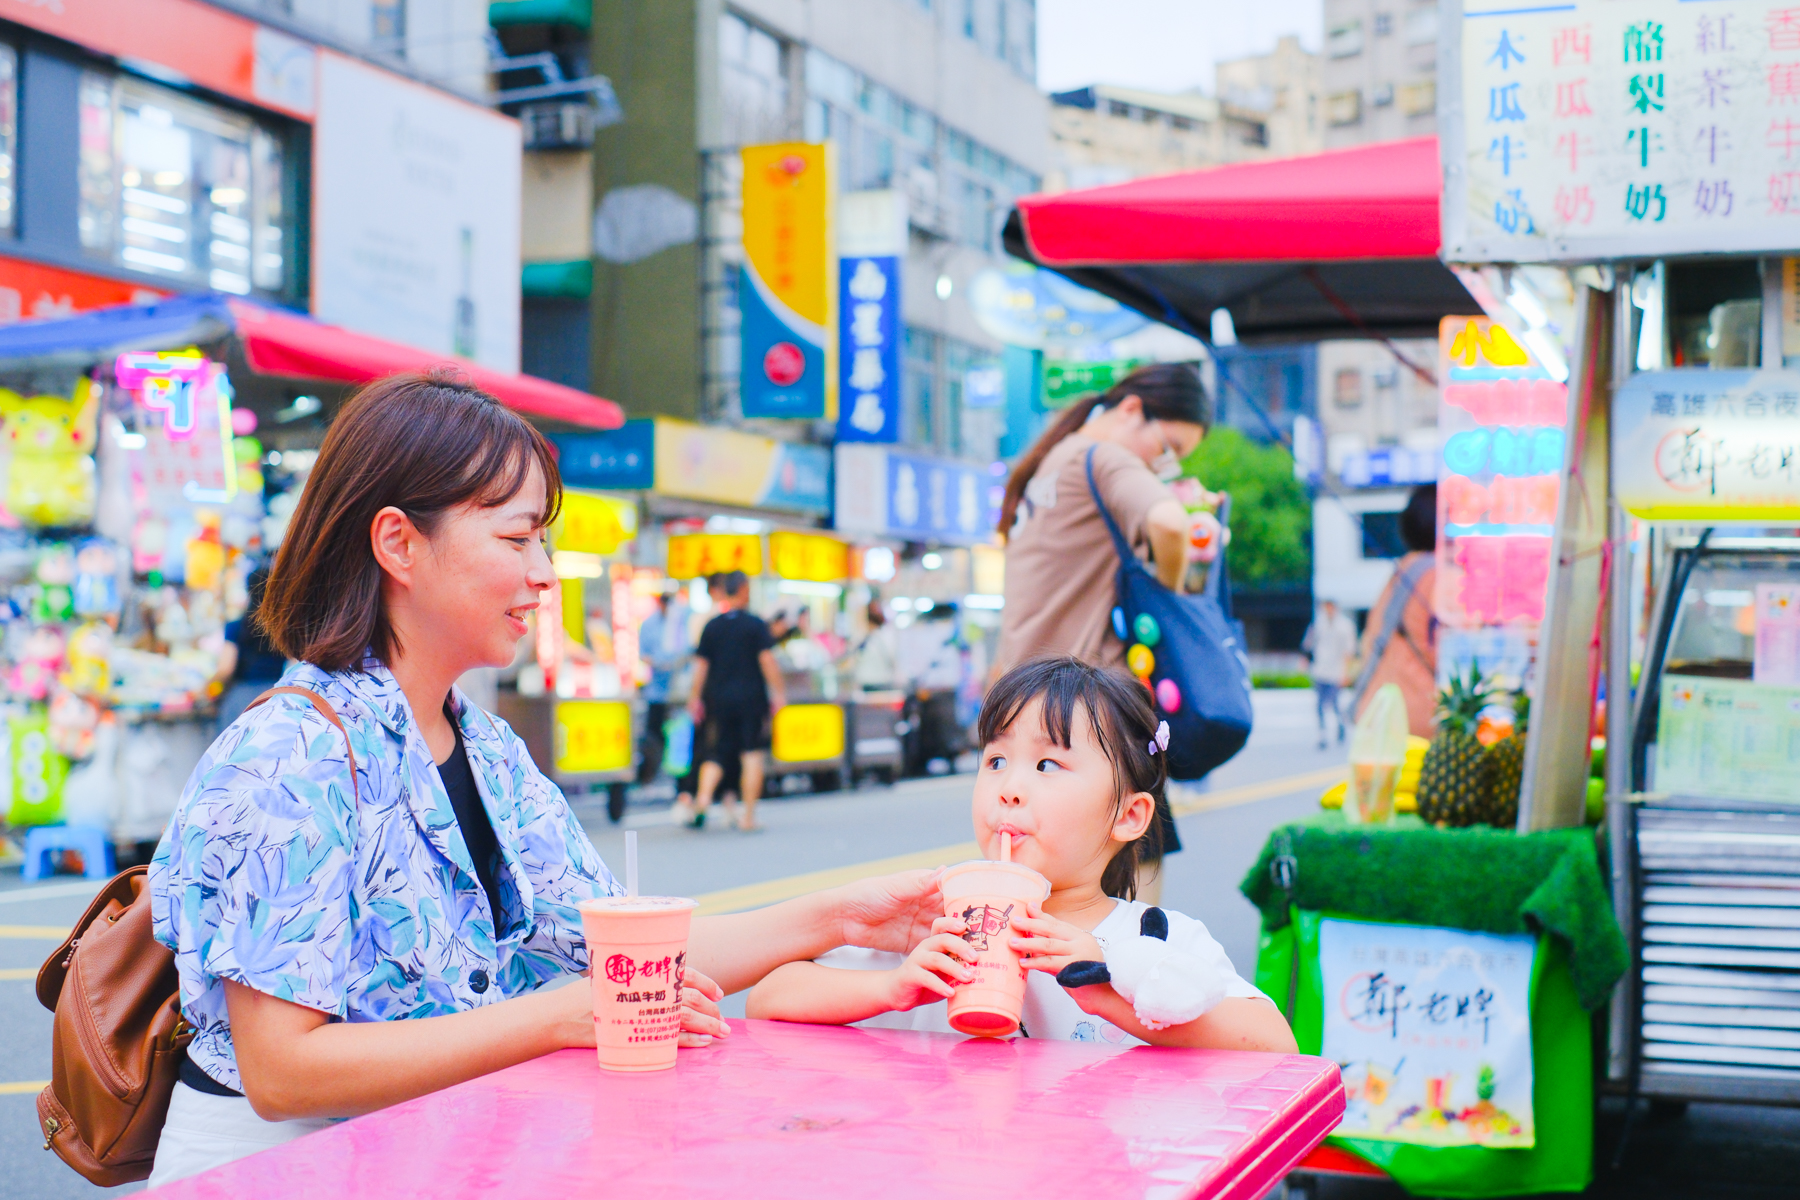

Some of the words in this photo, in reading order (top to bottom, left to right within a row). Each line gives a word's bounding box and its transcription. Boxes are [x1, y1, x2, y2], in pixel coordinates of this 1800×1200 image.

[1486, 30, 1535, 235] 木瓜牛奶
[1552, 22, 1594, 225] 西瓜牛奶
[1623, 21, 1667, 222] 酪梨牛奶
[1694, 13, 1734, 217] 紅茶牛奶
[605, 954, 671, 987] 鄭老牌
[616, 990, 666, 1002] 木瓜牛奶
[1342, 972, 1497, 1045] 鄭老牌
